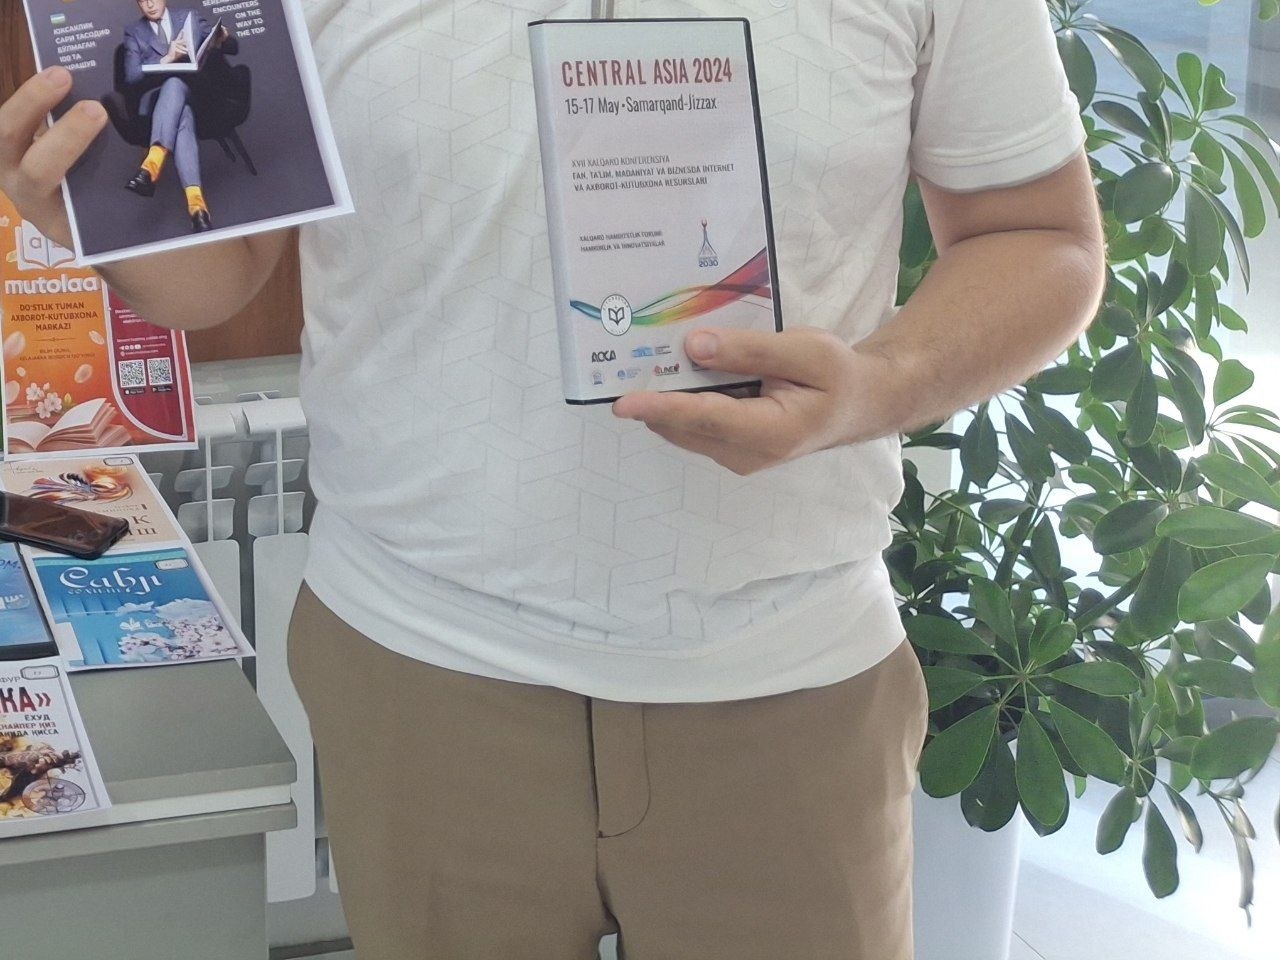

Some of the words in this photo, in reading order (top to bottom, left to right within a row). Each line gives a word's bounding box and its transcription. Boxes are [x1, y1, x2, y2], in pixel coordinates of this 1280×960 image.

[247, 9, 261, 17] THE
[235, 19, 252, 28] WAY
[236, 29, 250, 37] THE
[250, 26, 266, 35] TOP
[561, 59, 646, 87] CENTRAL
[653, 57, 689, 85] ASIA
[693, 56, 733, 83] 2024
[565, 97, 594, 115] 15-17
[598, 97, 620, 116] May
[5, 275, 100, 295] mutolaa
[55, 301, 85, 310] TUMAN
[35, 323, 72, 332] MARKAZI
